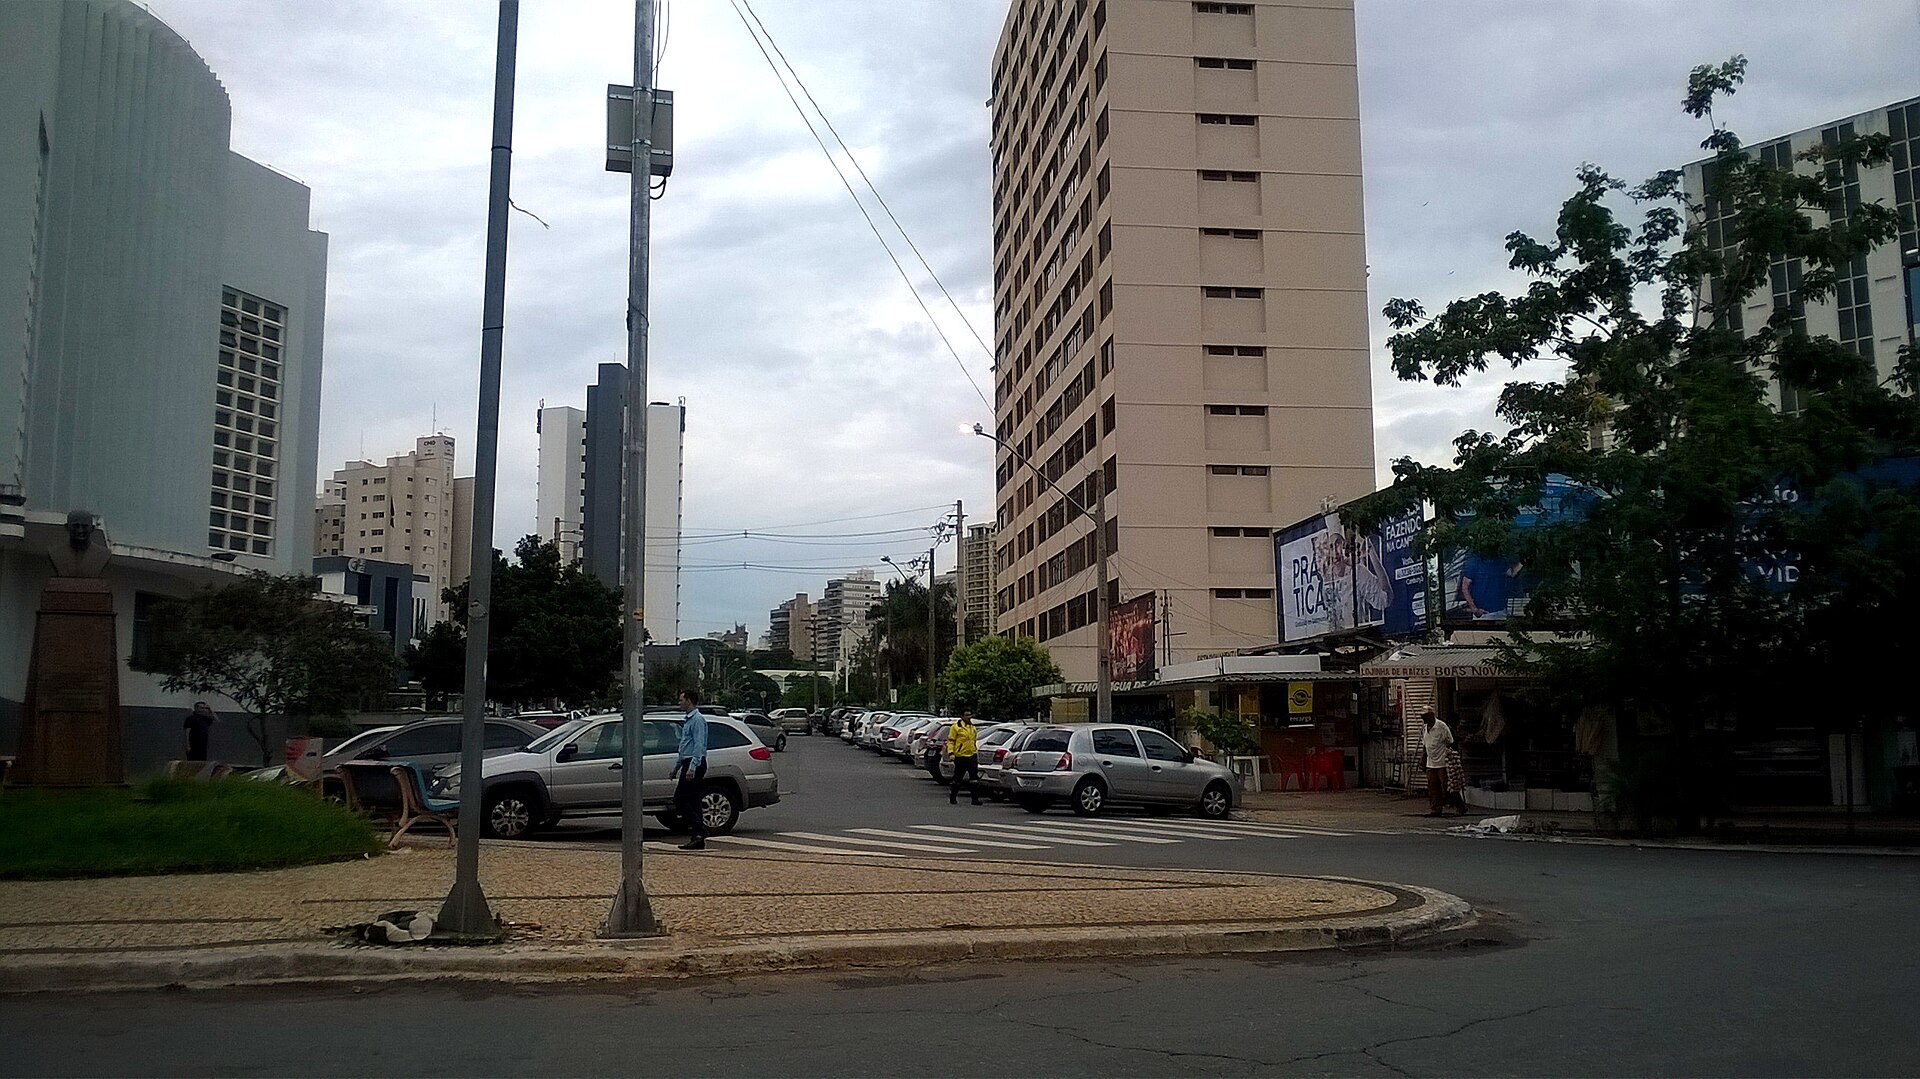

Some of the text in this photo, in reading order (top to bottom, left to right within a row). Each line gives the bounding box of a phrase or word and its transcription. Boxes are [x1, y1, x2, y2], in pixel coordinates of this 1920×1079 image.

[1293, 555, 1321, 587] PRA
[1293, 578, 1326, 617] TICA
[1392, 666, 1400, 676] DE
[1071, 682, 1098, 692] TEMO
